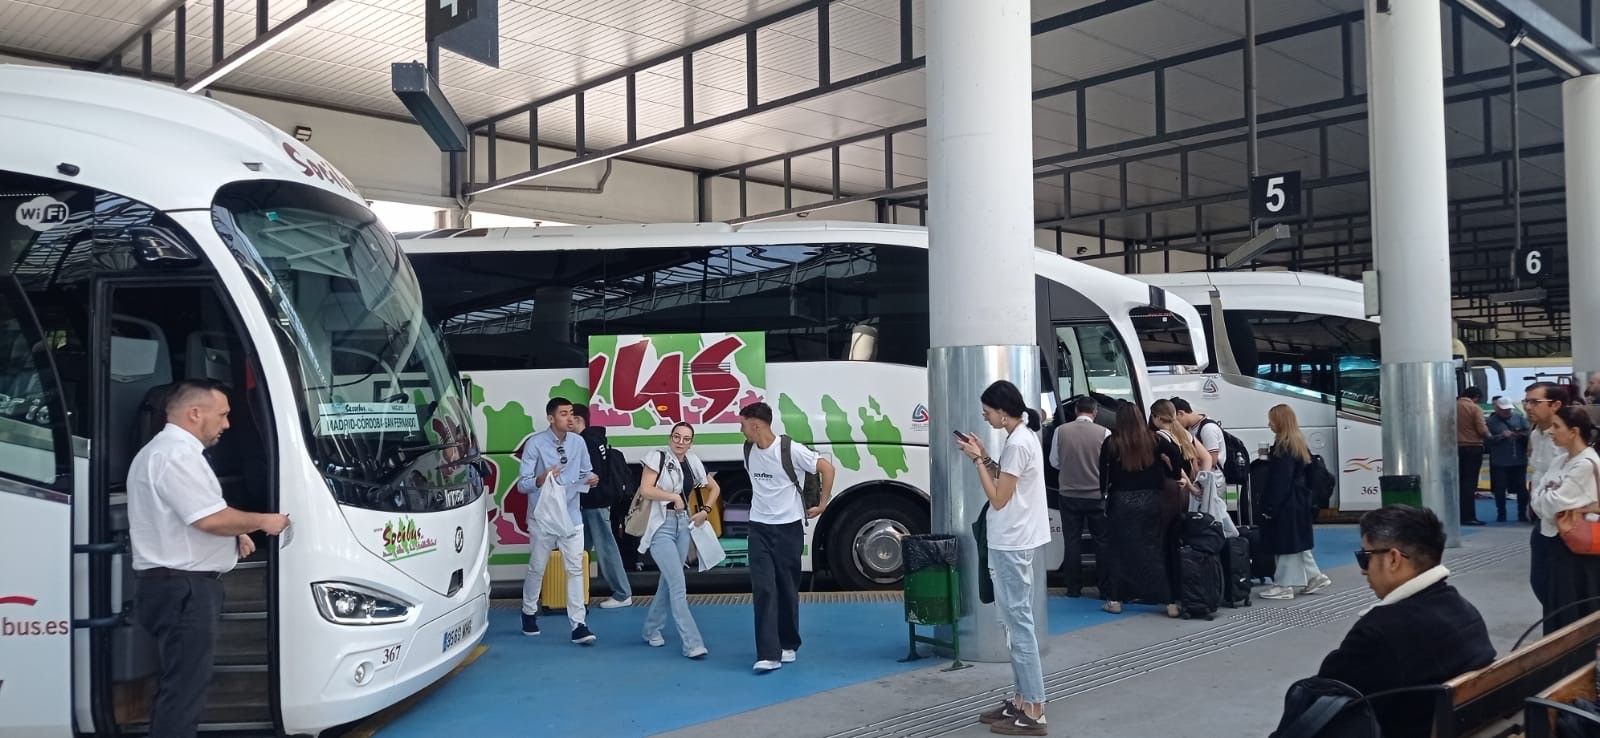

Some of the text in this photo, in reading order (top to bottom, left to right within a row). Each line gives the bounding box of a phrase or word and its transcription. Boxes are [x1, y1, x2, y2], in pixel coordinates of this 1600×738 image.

[1265, 176, 1285, 212] 5
[1526, 250, 1541, 275] 6
[1361, 486, 1378, 495] 365
[2, 617, 68, 636] bus.es
[382, 645, 401, 664] 367
